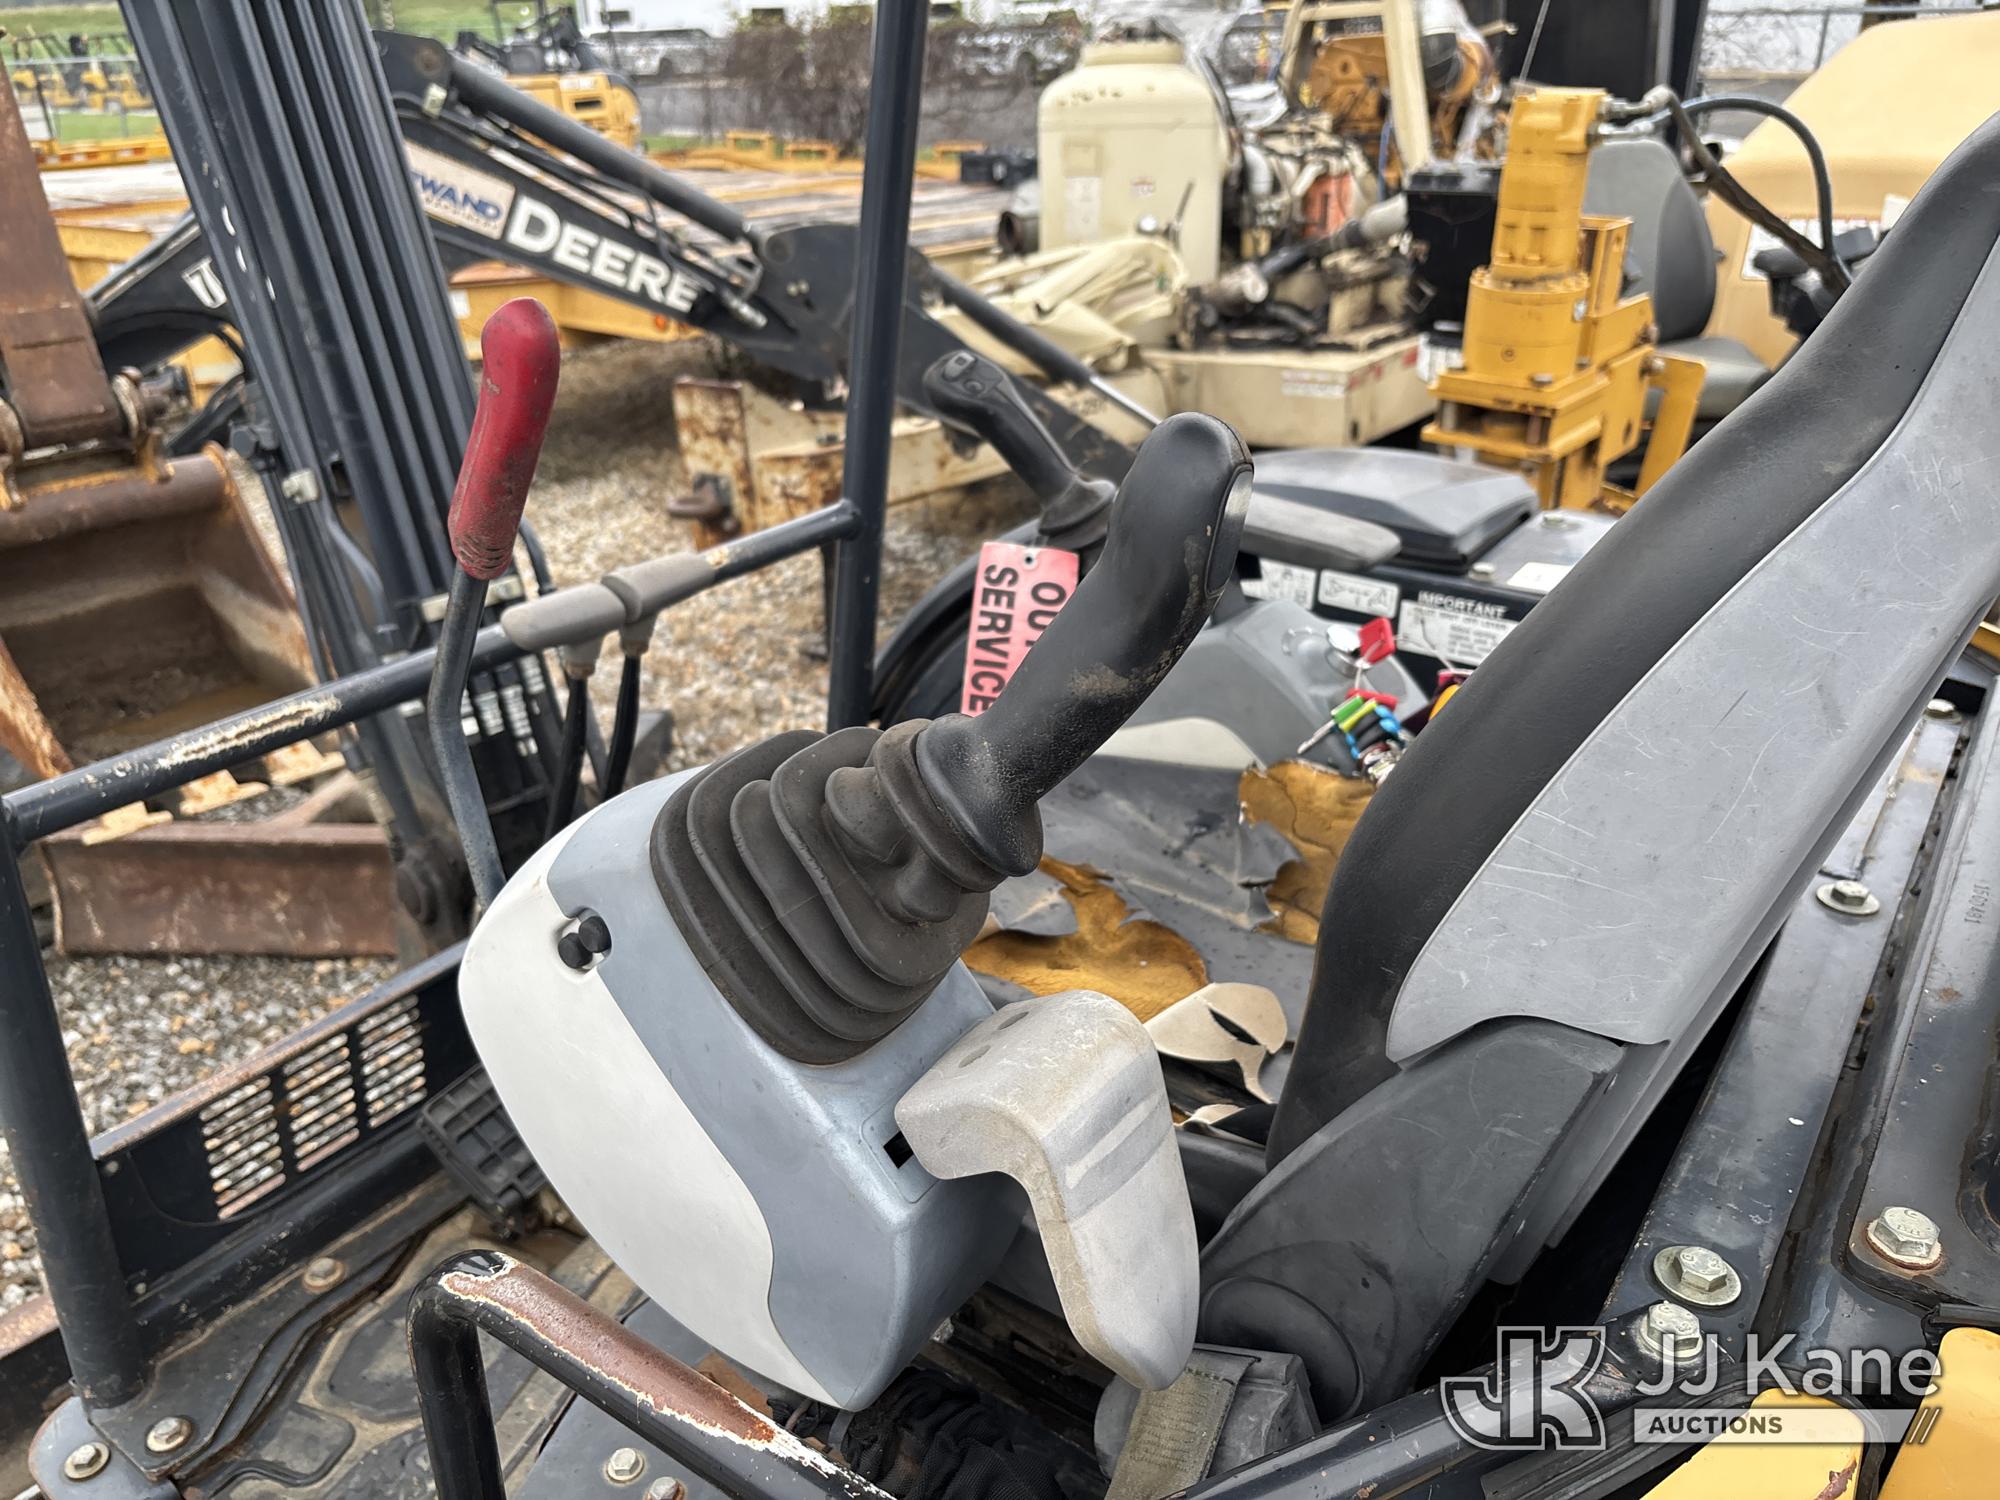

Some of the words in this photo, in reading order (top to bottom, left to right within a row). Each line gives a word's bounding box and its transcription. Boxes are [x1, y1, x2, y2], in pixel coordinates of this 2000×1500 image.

[506, 195, 701, 313] DEERE
[968, 564, 1019, 713] SERVICE
[1025, 582, 1067, 647] OU
[1418, 590, 1507, 619] IMPORTANT
